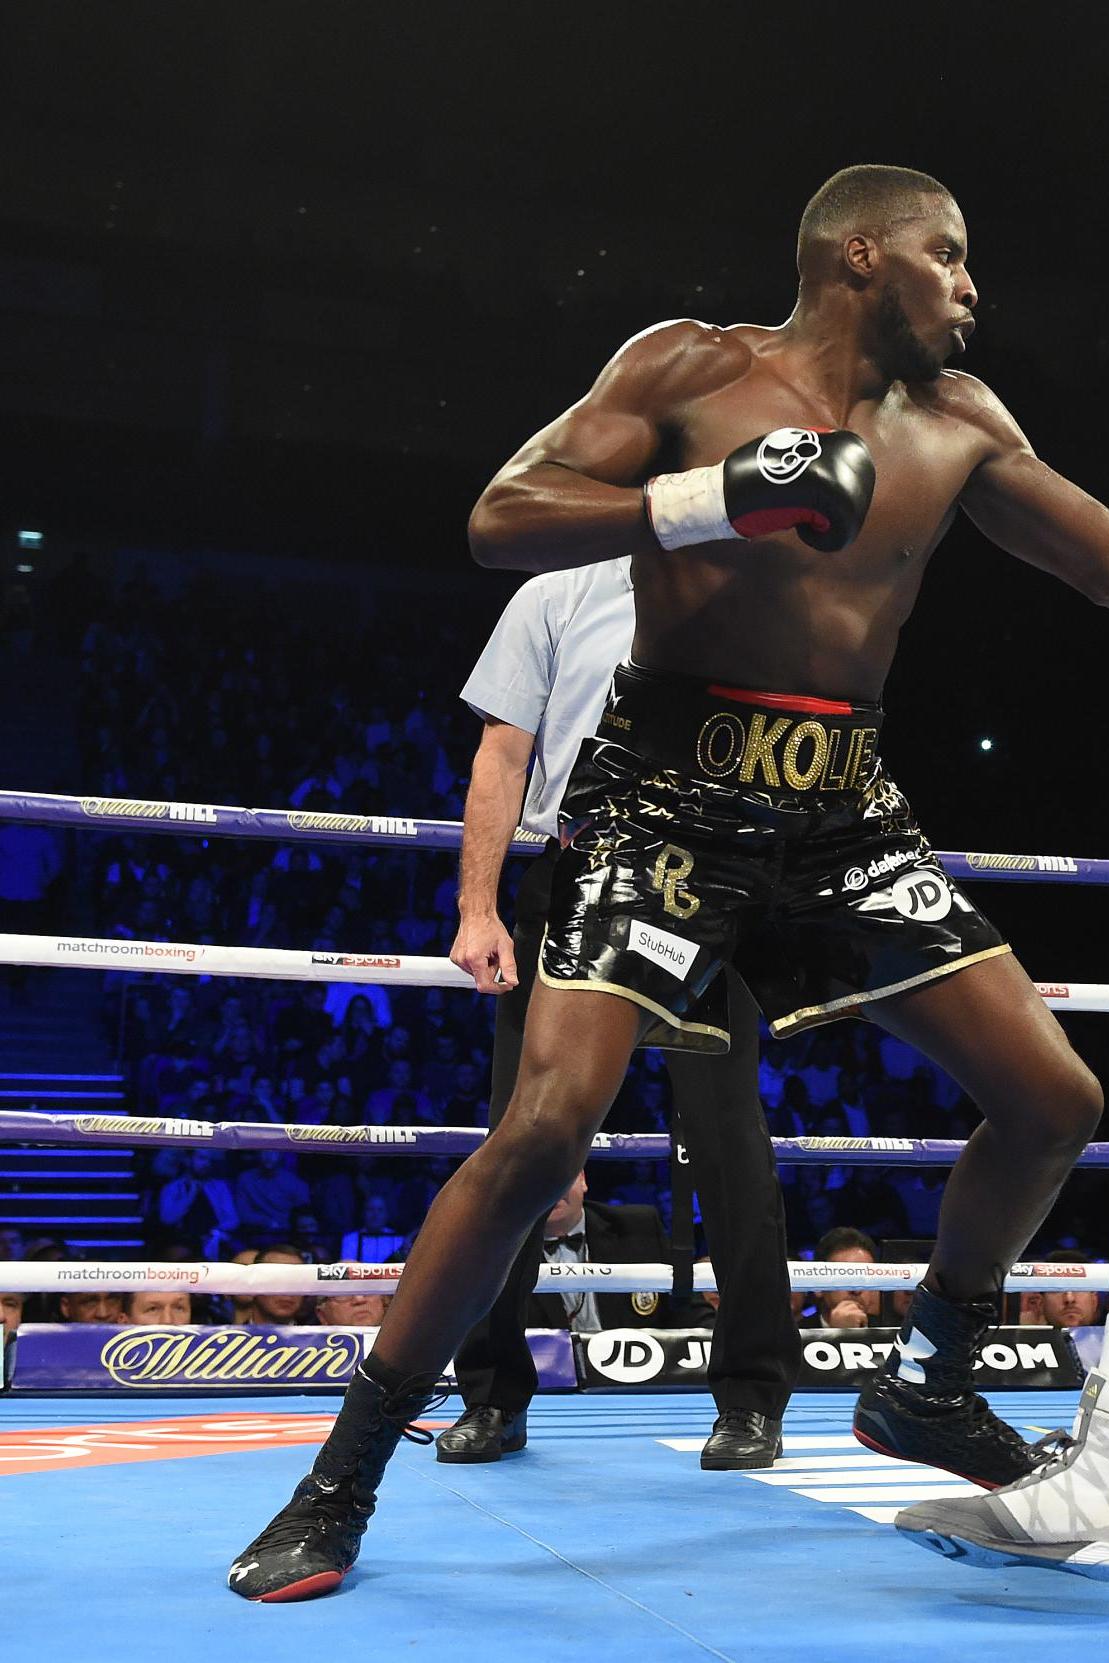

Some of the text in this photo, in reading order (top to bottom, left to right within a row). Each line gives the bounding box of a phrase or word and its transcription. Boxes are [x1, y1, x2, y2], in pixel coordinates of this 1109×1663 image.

[697, 713, 877, 791] OKOLIE
[1037, 855, 1078, 871] HILL
[907, 880, 942, 916] JD
[57, 942, 197, 962] matchroomboxing
[638, 932, 686, 966] StubHub
[57, 1265, 200, 1284] matchroomboxing
[319, 1265, 404, 1281] sky sports
[793, 1264, 911, 1280] matchroomboxing
[1010, 1264, 1084, 1277] sky sports
[101, 1325, 360, 1384] William
[601, 1341, 652, 1367] JD
